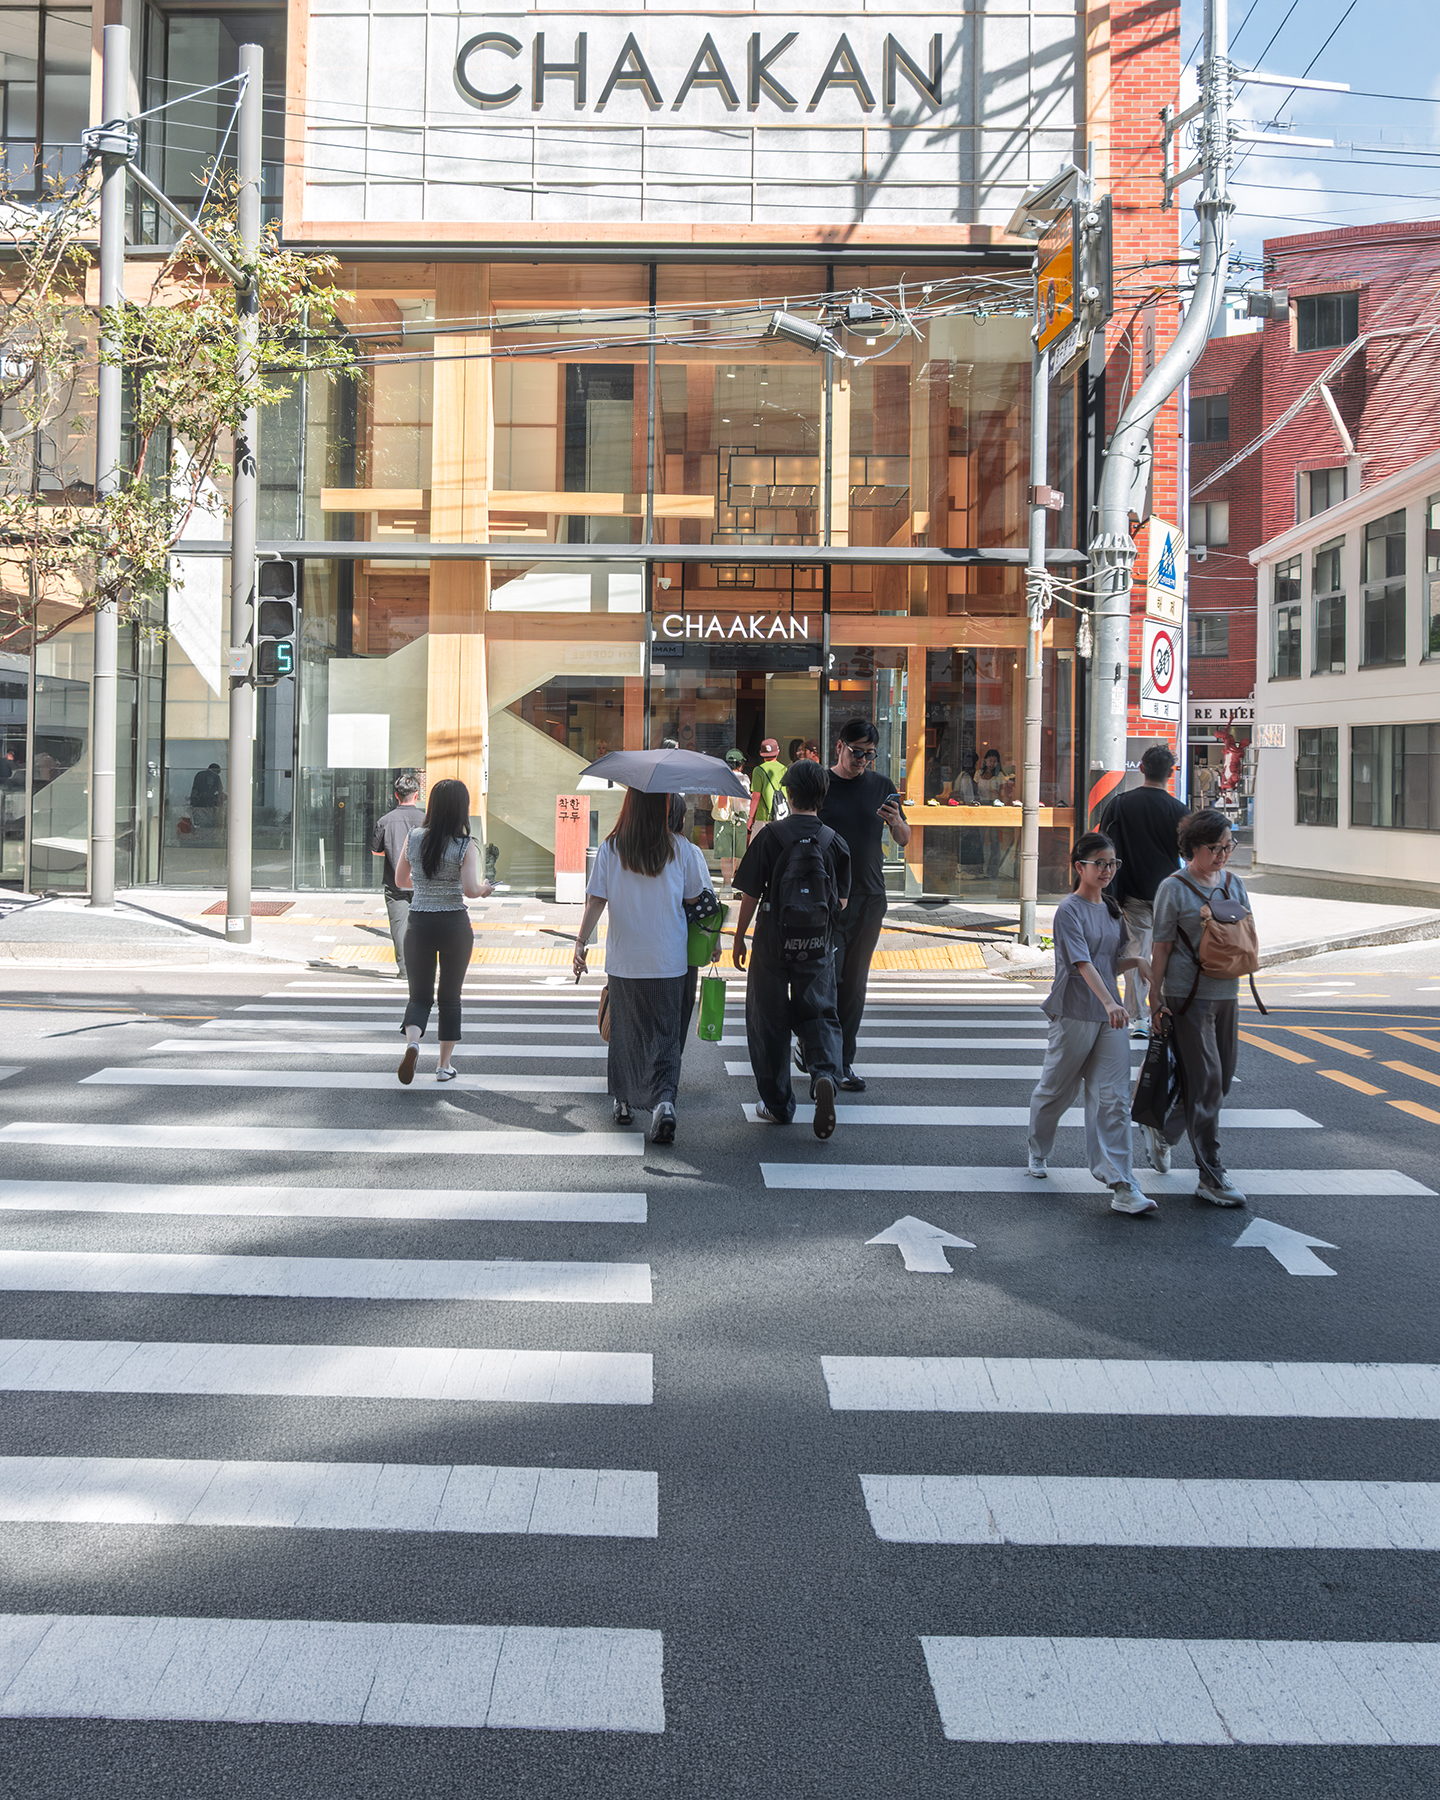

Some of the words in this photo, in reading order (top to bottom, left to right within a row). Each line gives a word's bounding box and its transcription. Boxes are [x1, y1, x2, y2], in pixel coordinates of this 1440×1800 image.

[455, 31, 943, 112] CHAAKAN
[662, 614, 808, 639] CHAAKAN
[277, 644, 292, 671] 5
[1195, 708, 1212, 719] RE
[558, 798, 580, 810] 착한
[558, 811, 580, 823] 구두
[784, 938, 809, 950] NEW
[809, 936, 824, 949] ERA
